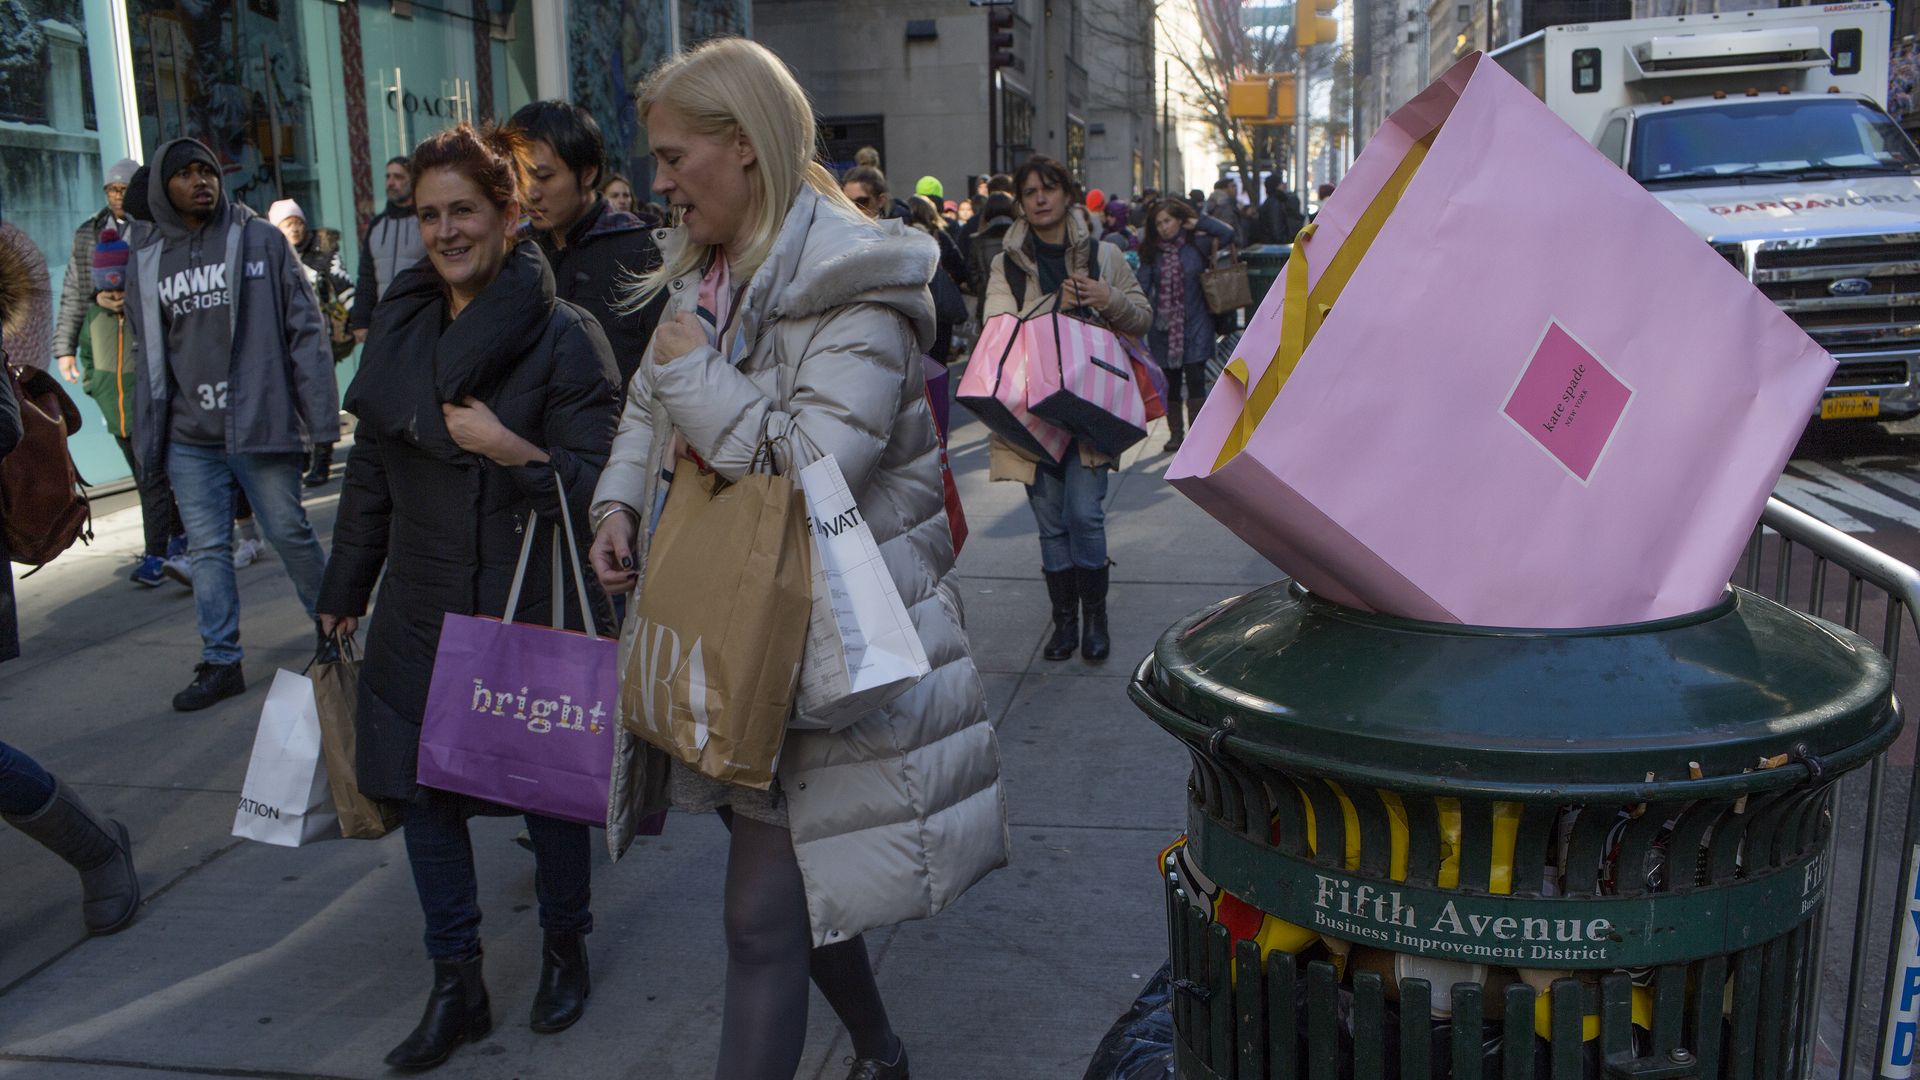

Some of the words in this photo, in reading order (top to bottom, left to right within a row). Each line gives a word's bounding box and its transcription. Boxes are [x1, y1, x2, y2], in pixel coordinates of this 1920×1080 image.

[246, 261, 264, 276] M
[1543, 403, 1565, 432] kate
[1562, 364, 1587, 403] spade
[1565, 410, 1577, 427] NEW
[1575, 390, 1588, 409] YORK
[471, 678, 606, 734] bright
[239, 797, 279, 820] ATION
[1314, 874, 1417, 928] Fifth
[1429, 900, 1613, 942] Avenue
[1315, 910, 1389, 942] Business
[1394, 929, 1525, 960] Improvement
[1530, 945, 1607, 961] District
